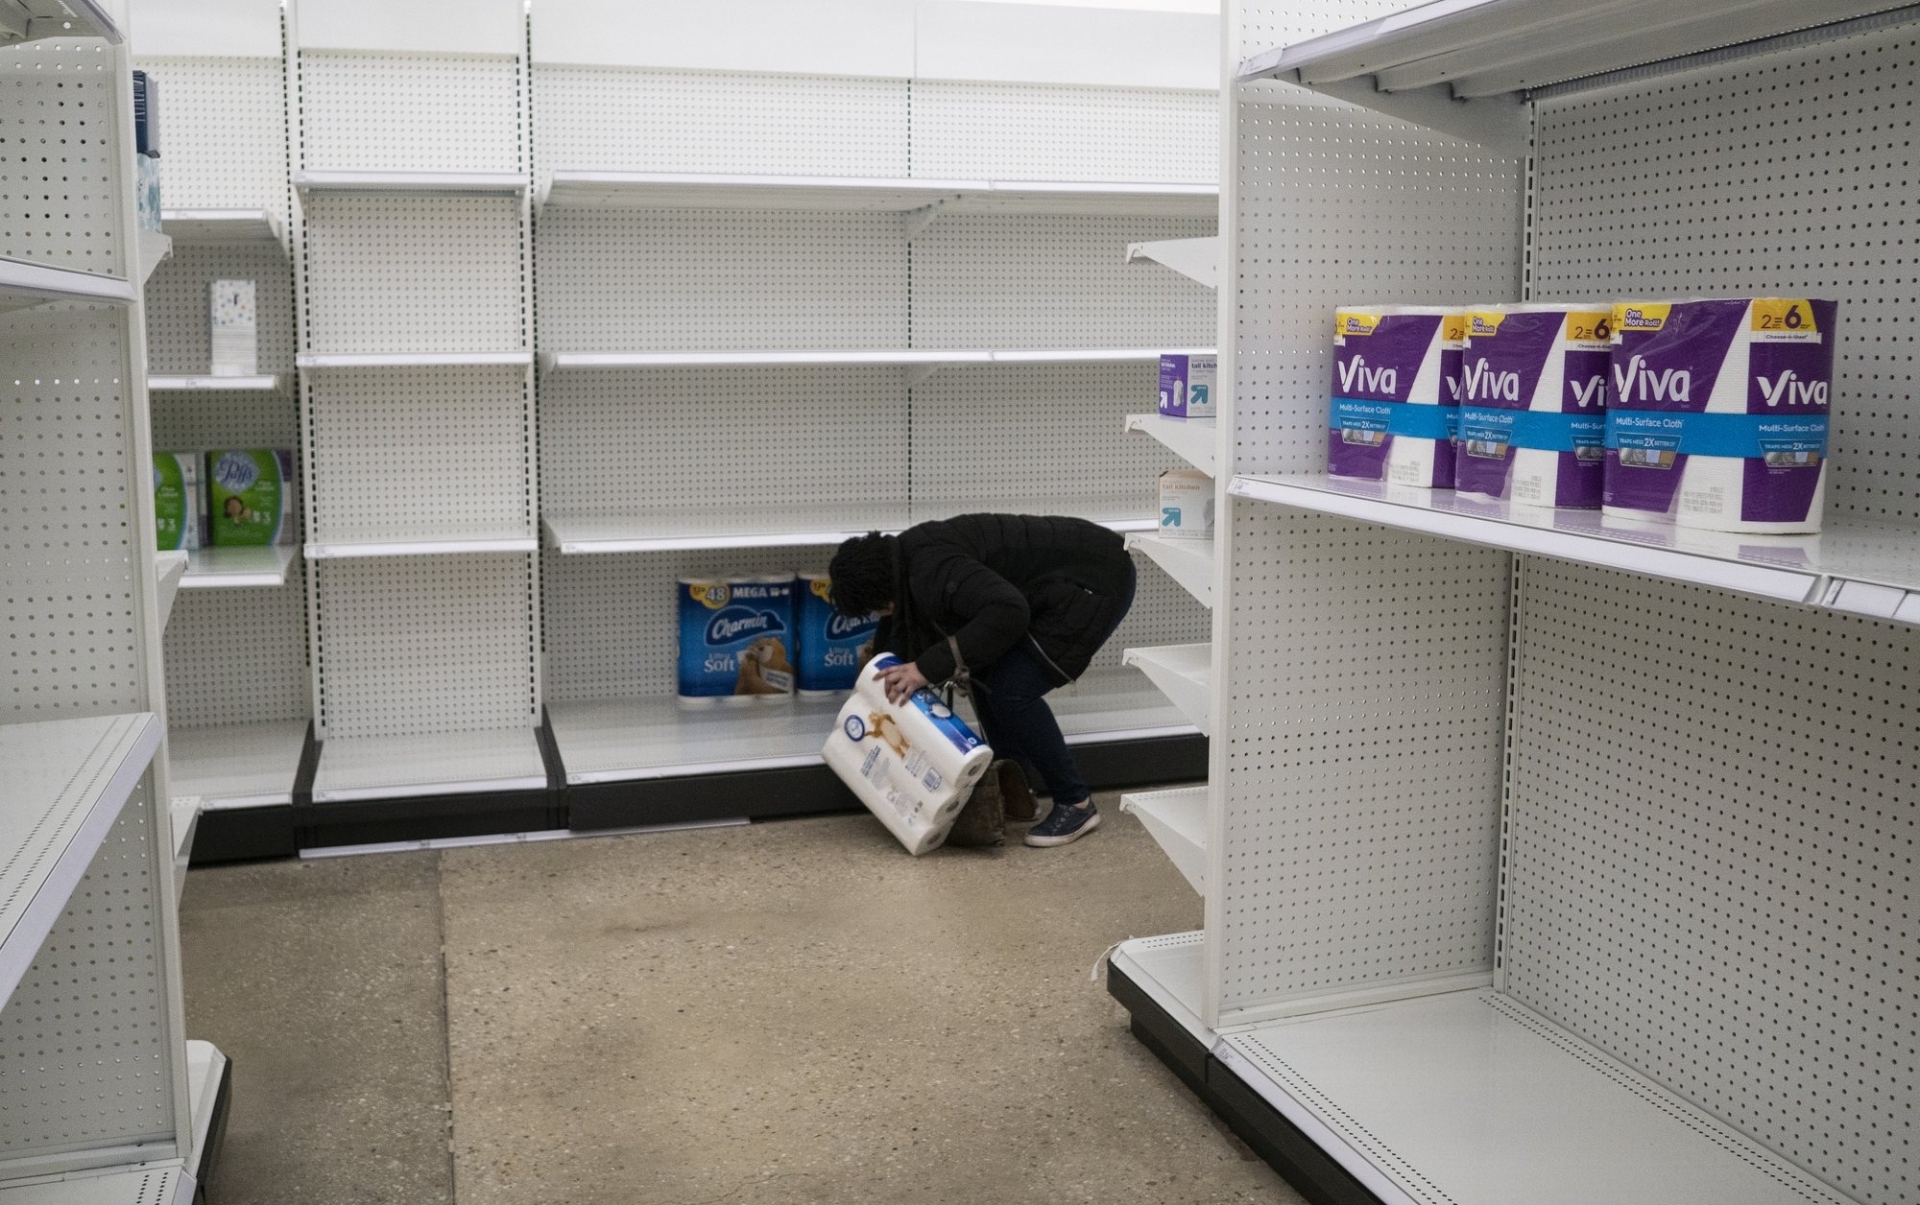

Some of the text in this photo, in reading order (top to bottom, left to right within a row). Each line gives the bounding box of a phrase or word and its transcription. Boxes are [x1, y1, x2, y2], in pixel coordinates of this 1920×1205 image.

[1627, 309, 1641, 318] One
[1626, 317, 1644, 326] More
[1338, 354, 1397, 395] Viva
[1465, 357, 1519, 401] Viva
[1614, 354, 1691, 403] Viva
[1570, 375, 1608, 407] Vi
[1756, 369, 1828, 407] Viva
[1340, 403, 1390, 414] Multi-Surface Cloth
[1465, 411, 1498, 422] Multi-Surface
[1499, 414, 1513, 424] Cloth
[1616, 416, 1683, 428] Multi-Surface Cloth
[1361, 421, 1370, 429] 2X
[1759, 424, 1809, 432] Multi-Surface
[1644, 437, 1655, 447] 2X
[1793, 442, 1803, 450] 2X
[219, 459, 254, 483] Puffs
[706, 586, 726, 601] 48
[733, 587, 768, 598] MEGA
[711, 616, 767, 639] Charmin
[704, 658, 735, 672] Soft
[824, 652, 854, 667] Soft
